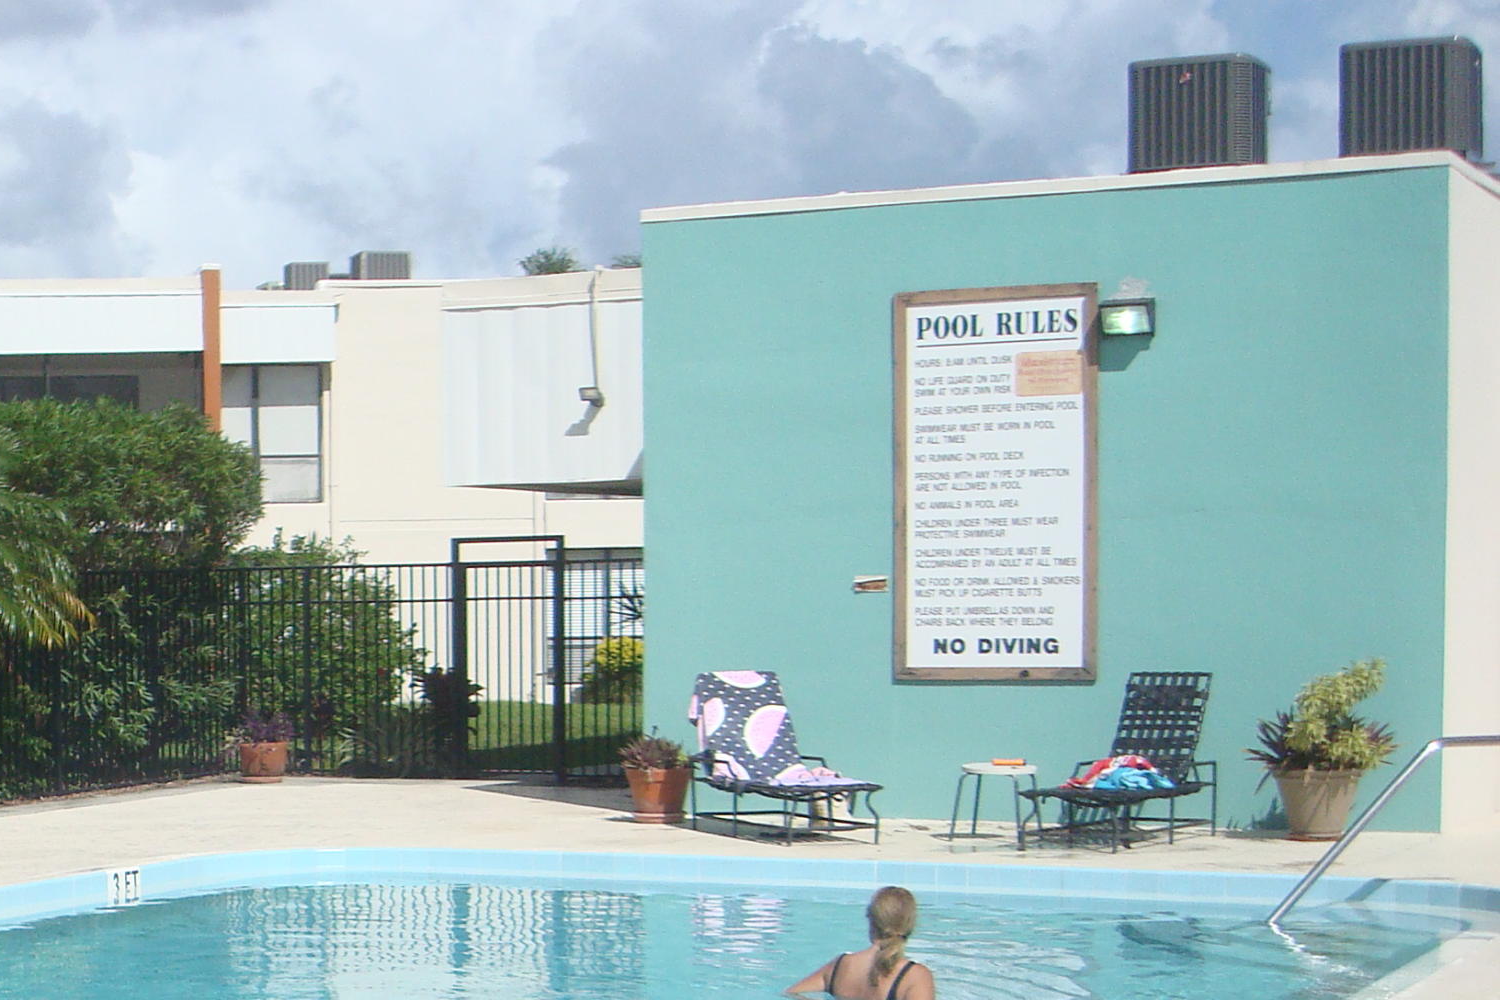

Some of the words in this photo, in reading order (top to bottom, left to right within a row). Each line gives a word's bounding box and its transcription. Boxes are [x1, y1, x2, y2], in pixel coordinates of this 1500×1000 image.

[917, 315, 983, 340] POOL
[997, 309, 1078, 335] RULES
[991, 355, 1012, 364] DUSK
[929, 377, 944, 385] LIFE
[947, 376, 973, 384] GUARD
[976, 375, 987, 383] ON
[990, 374, 1010, 382] DUTY
[915, 389, 935, 397] SWIM
[950, 387, 970, 395] YOUR
[973, 386, 991, 395] OWN
[994, 385, 1011, 393] RISK
[915, 407, 942, 415] PLEASE
[946, 405, 978, 414] SHOWER
[982, 404, 1011, 412] BEFORE
[1015, 402, 1054, 411] ENTERING
[1056, 402, 1078, 410] POOL
[960, 423, 980, 431] MUST
[998, 422, 1020, 430] WORN
[1034, 421, 1055, 429] POOL
[927, 436, 940, 444] ALL
[944, 435, 965, 443] TIMES
[915, 454, 925, 463] NO
[929, 453, 963, 462] RUNNING
[966, 453, 976, 461] ON
[980, 452, 1000, 460] POOL
[1004, 451, 1024, 459] DECK
[915, 472, 950, 480] PERSONS
[954, 471, 972, 479] WITH
[976, 470, 990, 478] ANY
[994, 470, 1012, 478] TYPE
[1016, 469, 1026, 477] OF
[1029, 468, 1069, 477] INFECTION
[915, 483, 929, 491] ARE
[933, 483, 948, 491] NOT
[951, 482, 986, 490] ALLOWED
[1001, 481, 1022, 489] POOL
[915, 501, 926, 509] NO
[930, 500, 961, 509] ANIMALS
[965, 500, 972, 508] IN
[975, 500, 995, 508] POOL
[999, 500, 1018, 508] AREA
[915, 520, 952, 528] CHILDREN
[956, 519, 981, 527] UNDER
[984, 518, 1008, 526] THREE
[915, 530, 959, 539] PROTECTIVE
[963, 529, 1005, 538] SWIMWEAR
[915, 549, 952, 557] CHILDREN
[955, 548, 981, 556] UNDER
[1017, 547, 1038, 555] MUST
[972, 559, 981, 567] BY
[1025, 558, 1034, 566] AT
[1037, 558, 1050, 566] ALL
[1054, 557, 1077, 566] TIMES
[915, 578, 926, 586] NO
[954, 577, 964, 585] OR
[968, 577, 989, 585] DRINK
[994, 577, 1029, 585] ALLOWED
[1042, 576, 1080, 584] SMOKERS
[915, 589, 935, 597] MUST
[939, 588, 956, 596] PICK
[959, 588, 969, 596] UP
[972, 587, 1013, 596] CIGARETTE
[1017, 587, 1042, 595] BUTTS
[964, 606, 1009, 615] UMBRELLAS
[1012, 606, 1035, 614] DOWN
[1039, 606, 1054, 614] AND
[915, 618, 942, 626] CHAIRS
[946, 618, 965, 626] BACK
[970, 617, 995, 626] WHERE
[999, 617, 1018, 625] THEY
[1022, 617, 1054, 625] BELONG
[933, 639, 965, 654] NO
[978, 638, 1059, 654] DIVING
